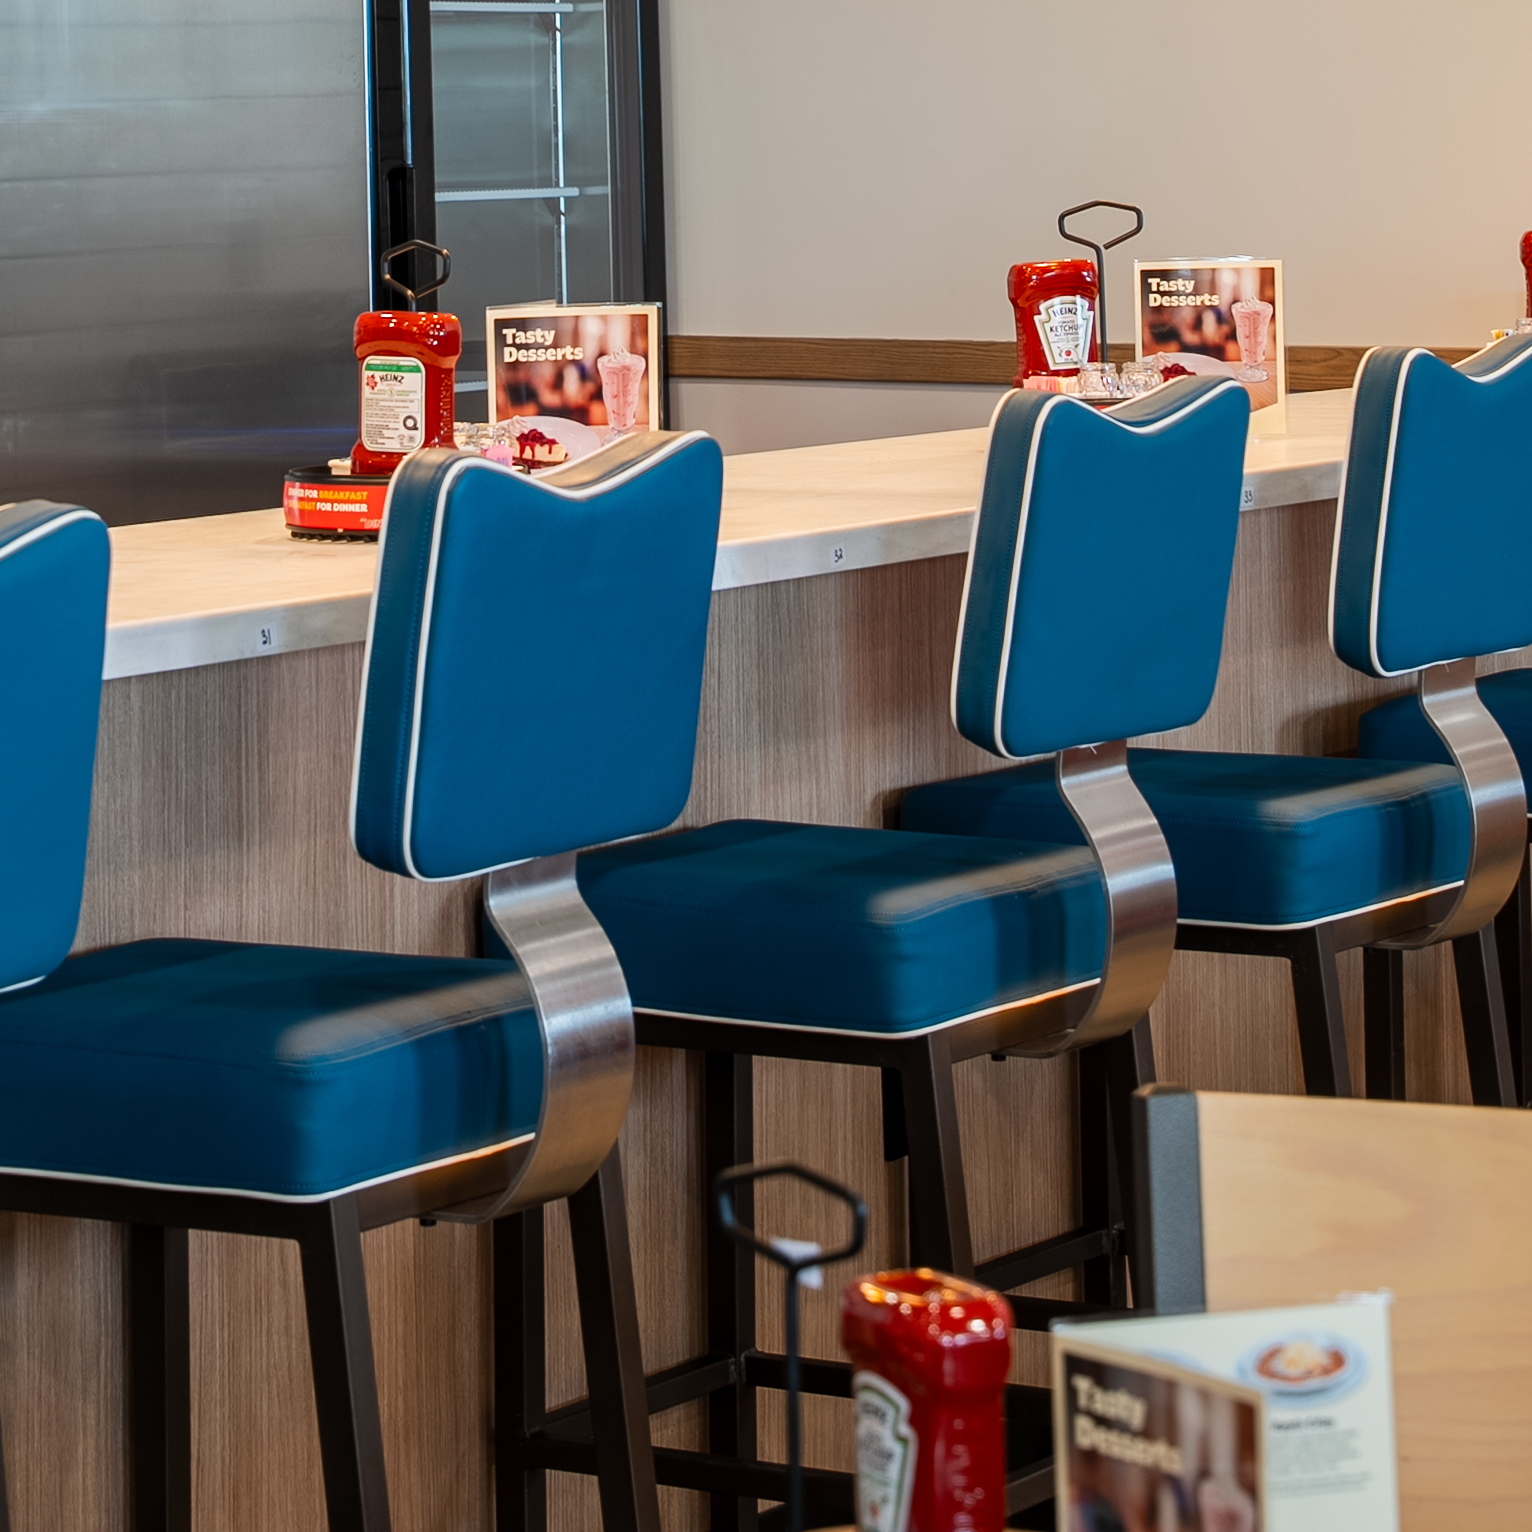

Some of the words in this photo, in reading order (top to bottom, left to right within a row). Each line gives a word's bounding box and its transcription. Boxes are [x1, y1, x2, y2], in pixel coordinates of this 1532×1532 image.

[1147, 278, 1195, 293] Tasty
[1148, 292, 1220, 307] Desserts
[1052, 306, 1077, 317] HEINZ
[1050, 323, 1083, 333] KETCHUP
[502, 328, 556, 346] Tasty
[503, 345, 584, 363] Desserts
[379, 374, 405, 384] HEINZ
[319, 490, 368, 500] BREAKFAST
[316, 502, 332, 511] FOR
[333, 502, 368, 512] DINNER
[1070, 1372, 1145, 1432] Tasty
[1074, 1412, 1183, 1473] Desserts
